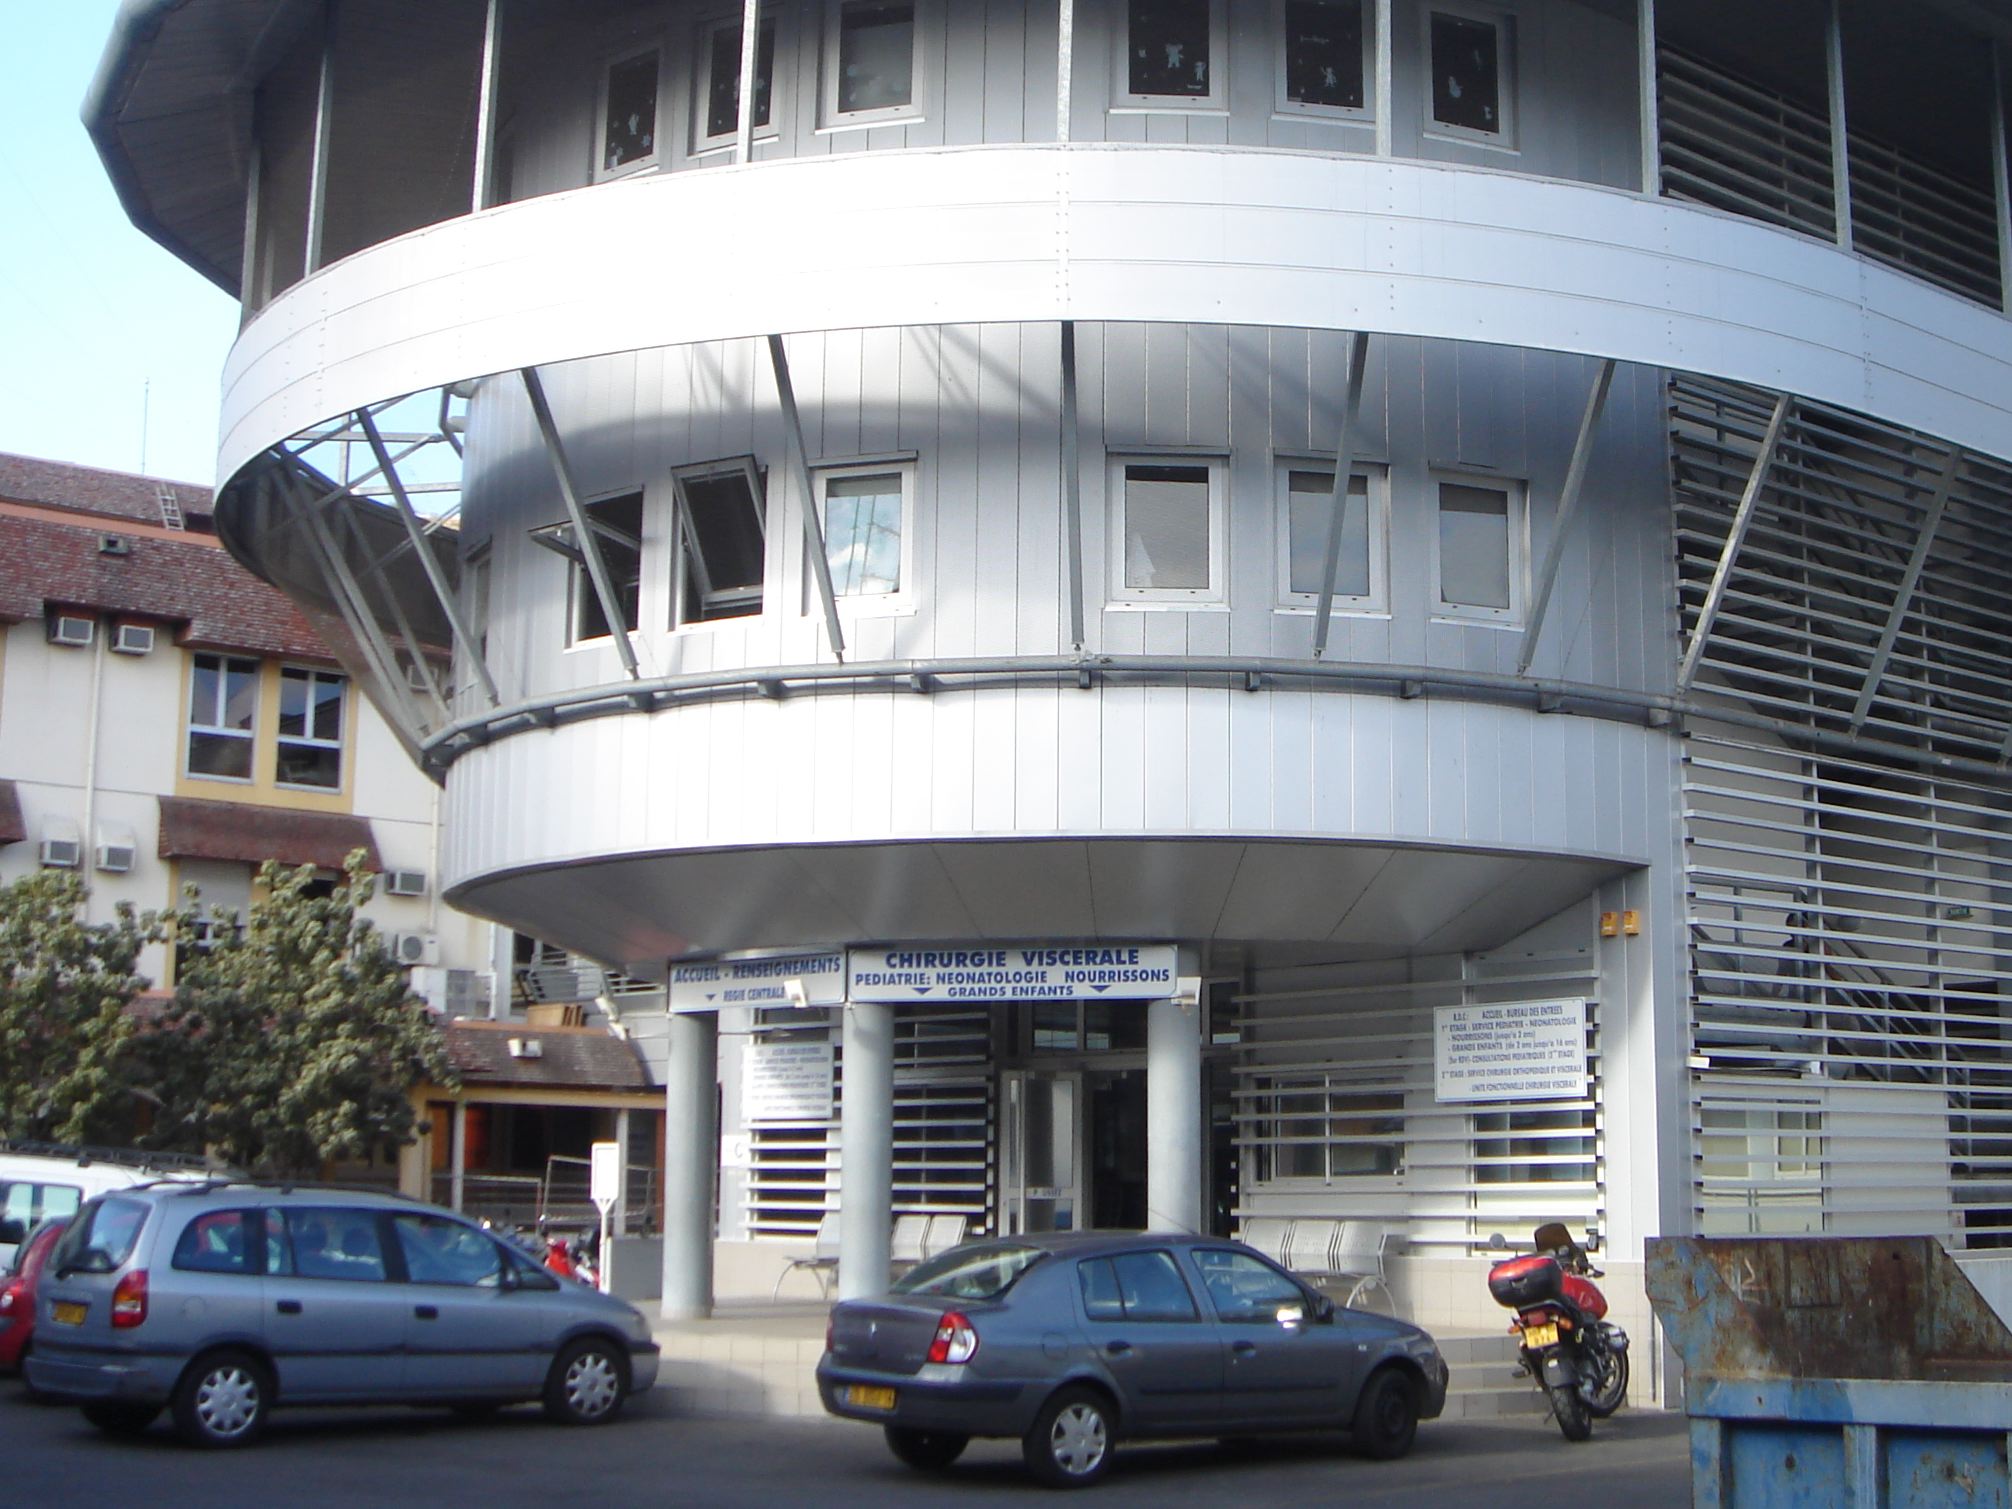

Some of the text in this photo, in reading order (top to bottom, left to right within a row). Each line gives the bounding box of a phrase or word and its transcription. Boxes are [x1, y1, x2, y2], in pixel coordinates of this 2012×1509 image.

[885, 948, 1139, 968] CHIRURGIE VISCERALE
[674, 965, 720, 983] ACCUEIL
[732, 957, 840, 979] RENSEIGNEMENTS
[855, 969, 1169, 986] PEDIATRIE: NEONATOLOGIE NOURRISSONS
[724, 989, 745, 1002] REGIE
[948, 984, 1074, 997] GRANDS ENFANTS
[1482, 1010, 1502, 1019] ACCUEIL
[1507, 1008, 1528, 1018] BUREAU
[1530, 1007, 1539, 1016] DES
[1472, 1022, 1494, 1030] SERVICE
[1530, 1017, 1577, 1026] NEONATOLOGIE
[1452, 1043, 1475, 1052] GRANDS
[1477, 1042, 1503, 1050] ENFANTS
